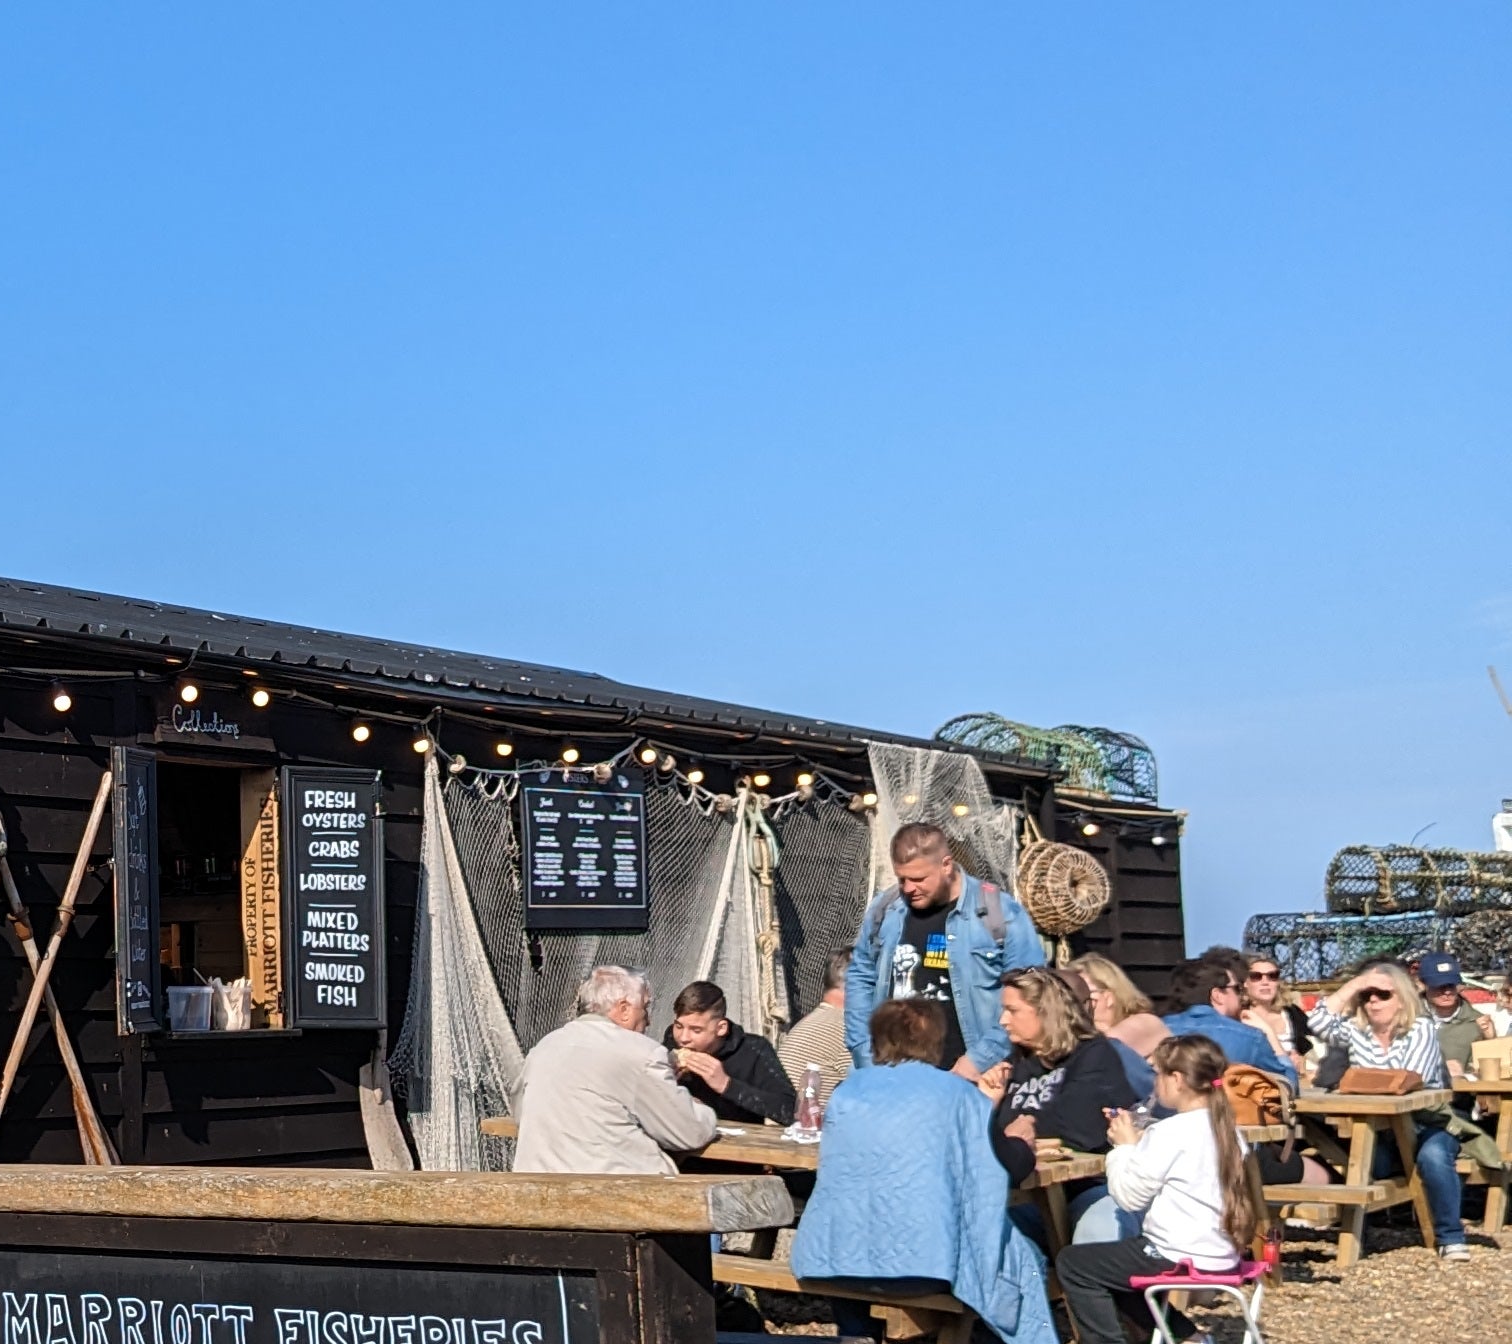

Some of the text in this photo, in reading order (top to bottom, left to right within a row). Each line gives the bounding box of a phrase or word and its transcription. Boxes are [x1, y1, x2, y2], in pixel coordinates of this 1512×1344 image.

[305, 790, 356, 808] FRESH
[302, 812, 366, 828] OYSTERS
[308, 840, 360, 858] CRABS
[299, 873, 366, 891] LOBSTERS
[245, 858, 257, 957] PROPERTY OF
[307, 911, 358, 930] MIXED
[302, 931, 369, 951] PLATTERS
[263, 909, 277, 1014] MARRIOTT
[305, 962, 365, 983] SMOKED
[317, 985, 357, 1007] FISH
